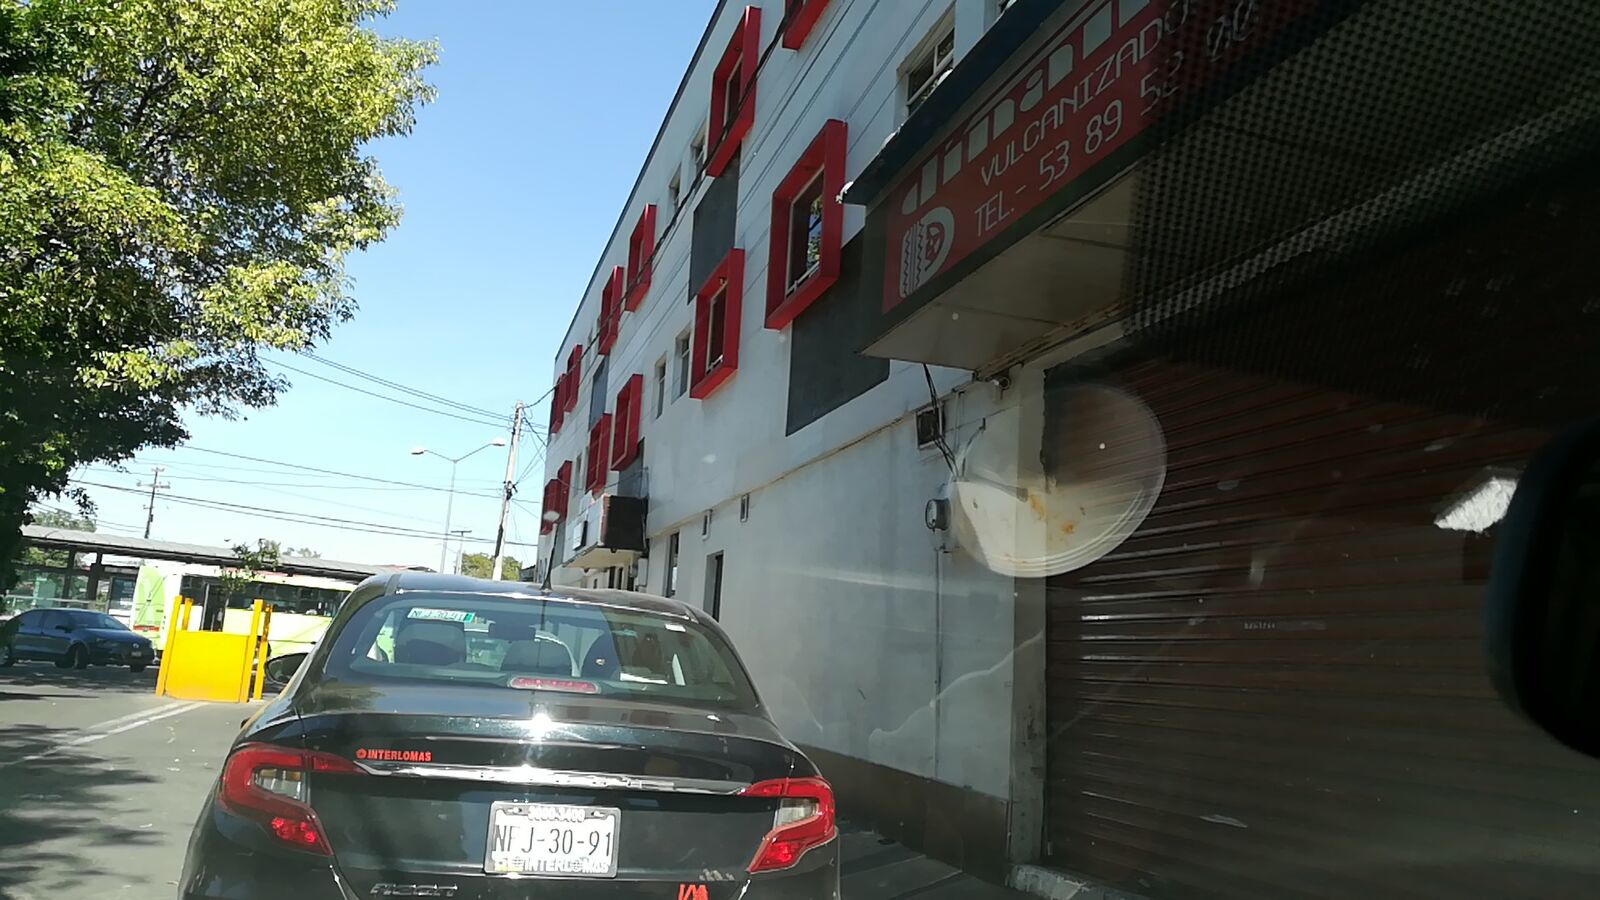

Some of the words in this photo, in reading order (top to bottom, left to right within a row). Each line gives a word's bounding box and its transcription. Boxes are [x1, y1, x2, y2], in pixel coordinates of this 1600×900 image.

[1039, 140, 1070, 191] 53
[1085, 99, 1122, 154] 89
[367, 749, 432, 762] INTERLOMAS
[494, 824, 611, 857] NFJ-30-91
